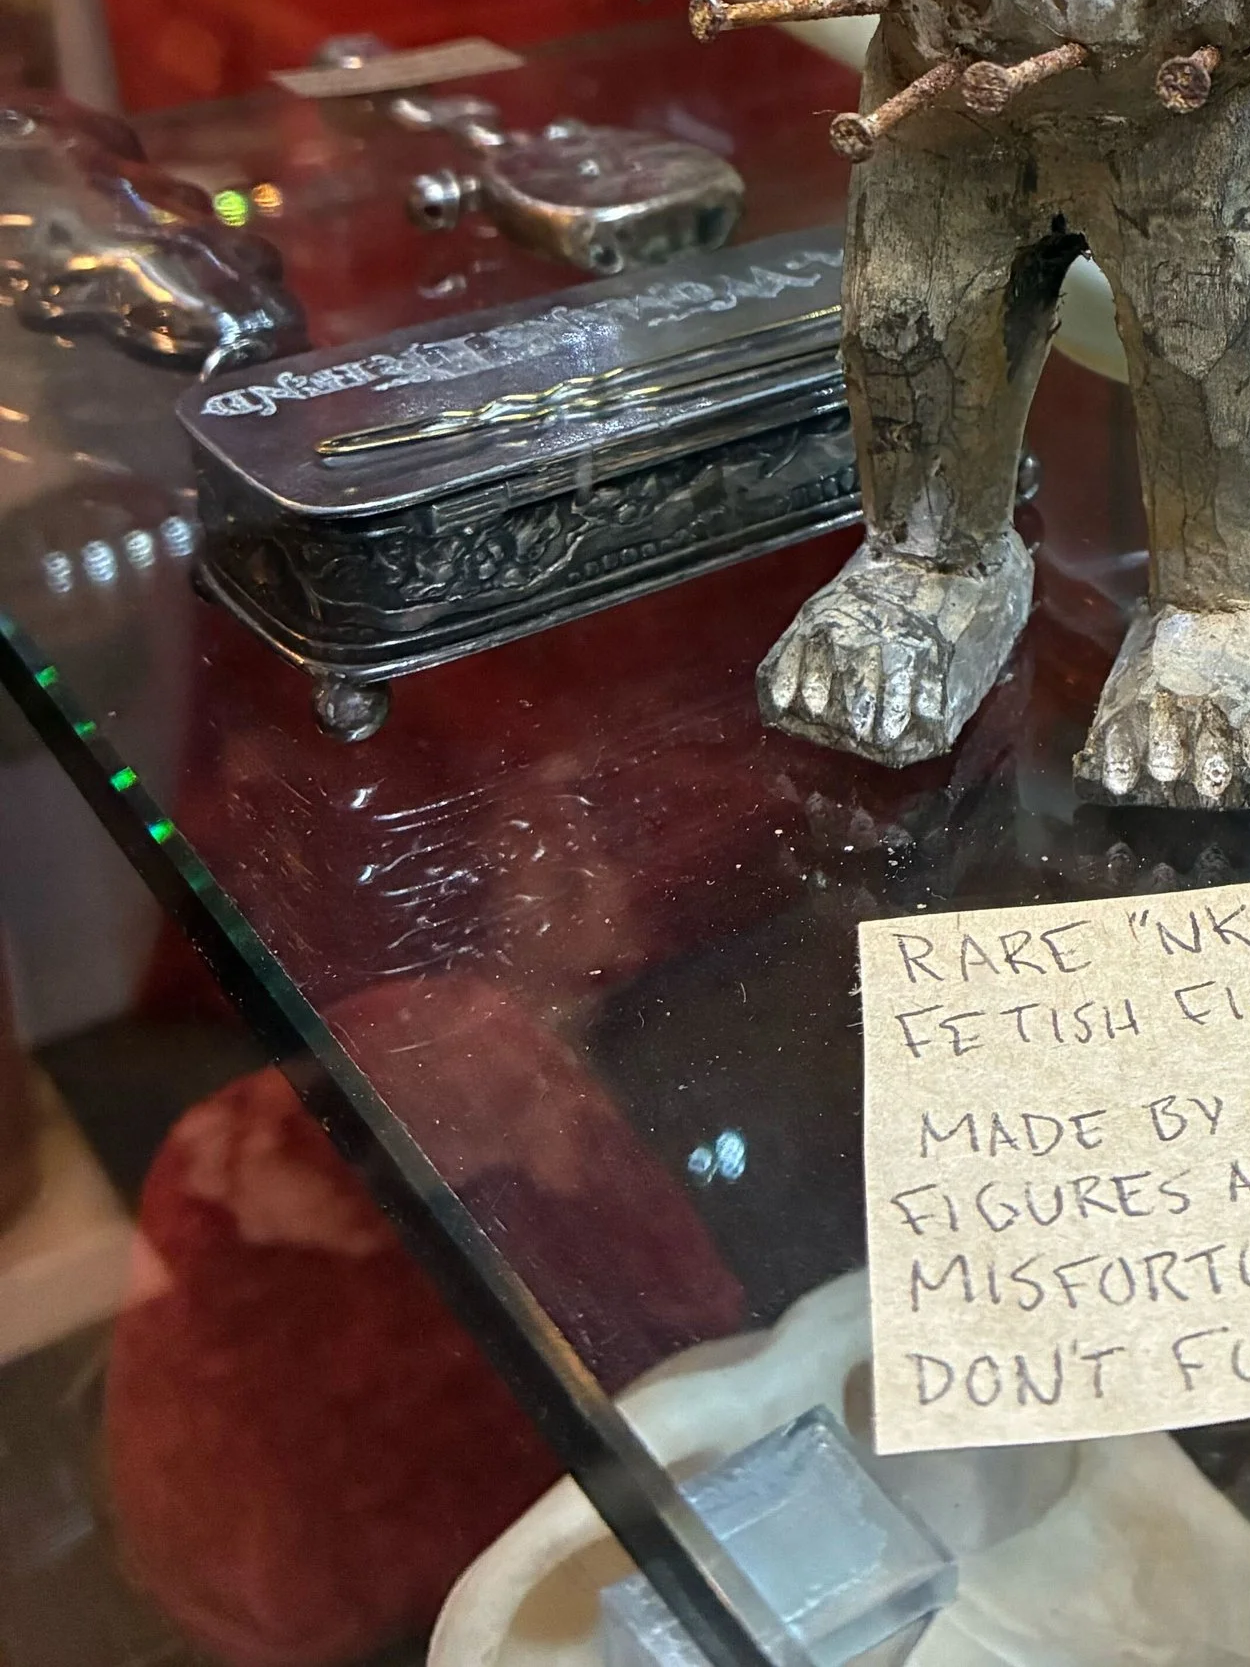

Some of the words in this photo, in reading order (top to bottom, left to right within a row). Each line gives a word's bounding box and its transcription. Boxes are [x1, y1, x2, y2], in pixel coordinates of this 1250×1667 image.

[893, 919, 1092, 984] RARE
[896, 999, 1141, 1058] FETISH
[920, 1109, 1107, 1159] MADE
[1143, 1095, 1223, 1142] BY
[890, 1169, 1190, 1235] FIGURES
[905, 1340, 1126, 1407] DON'T
